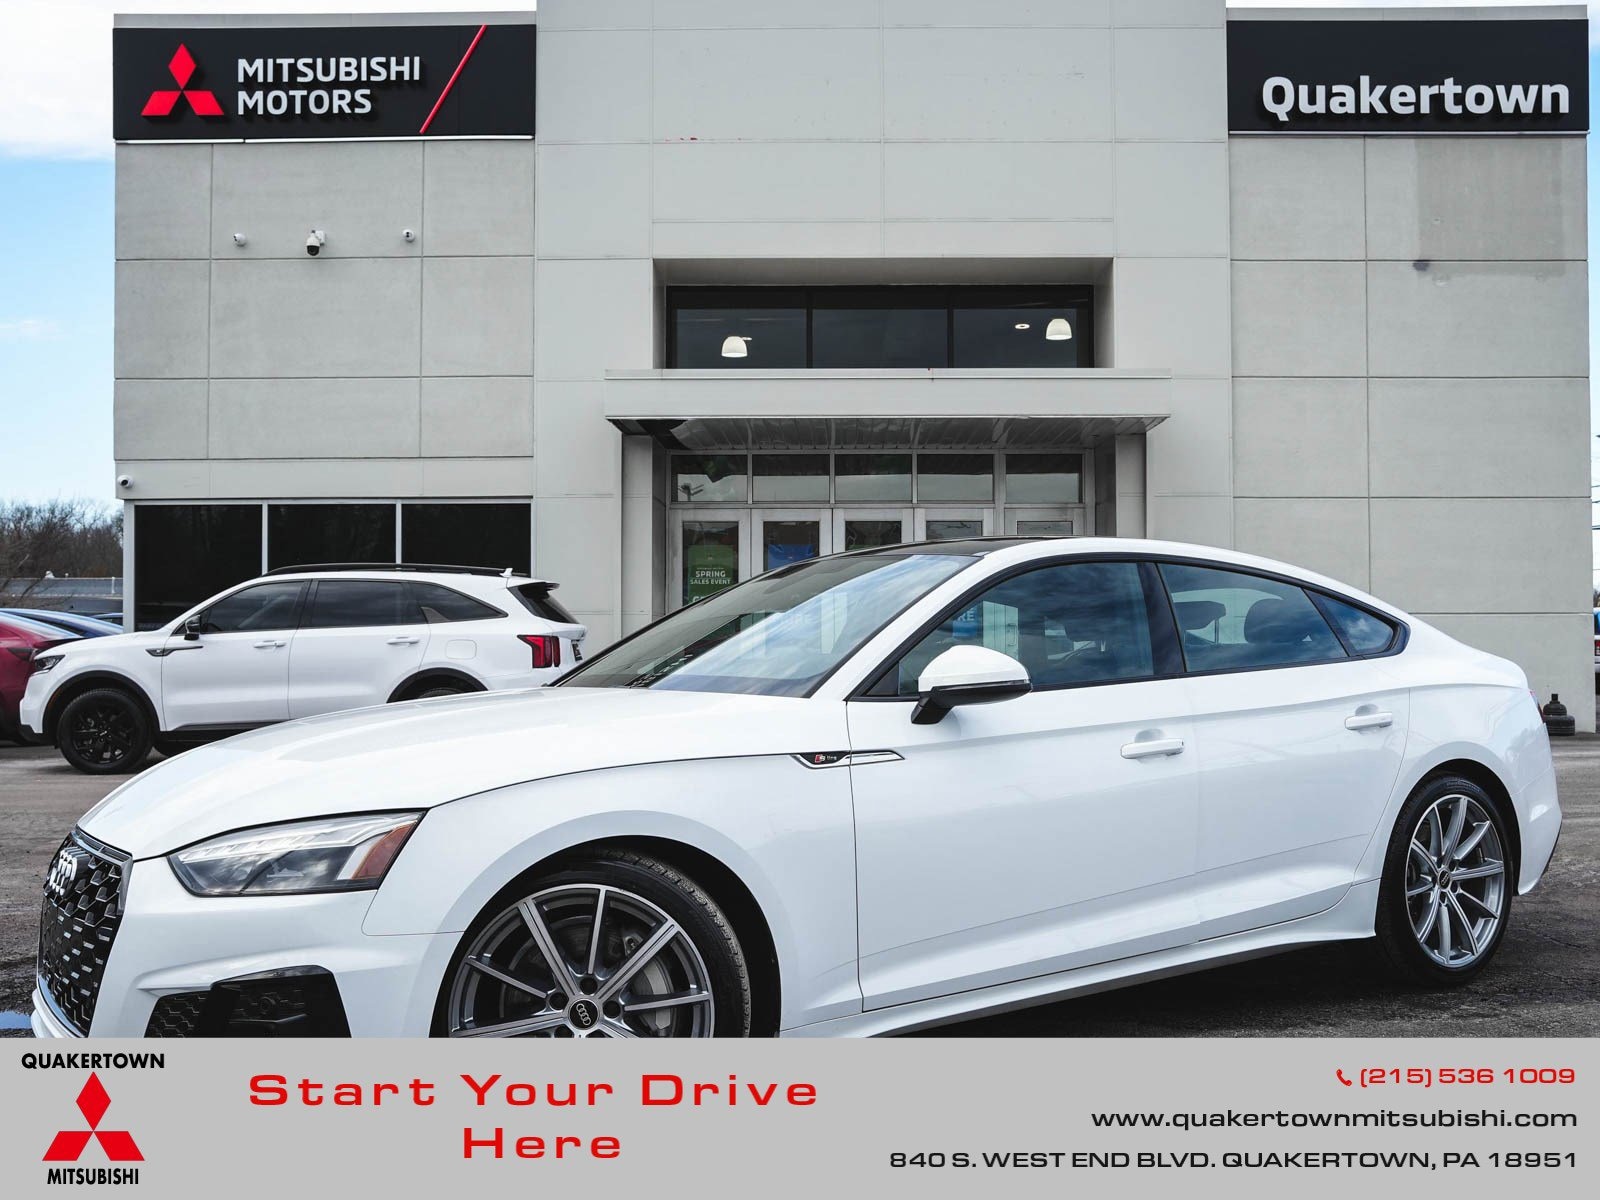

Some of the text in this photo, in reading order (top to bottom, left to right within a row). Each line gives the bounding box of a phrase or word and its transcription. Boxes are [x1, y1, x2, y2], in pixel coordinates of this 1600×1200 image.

[237, 54, 420, 83] MITSUBISHI
[237, 88, 372, 116] MOTORS
[1262, 75, 1569, 121] Quakertown
[695, 570, 726, 578] SPRING
